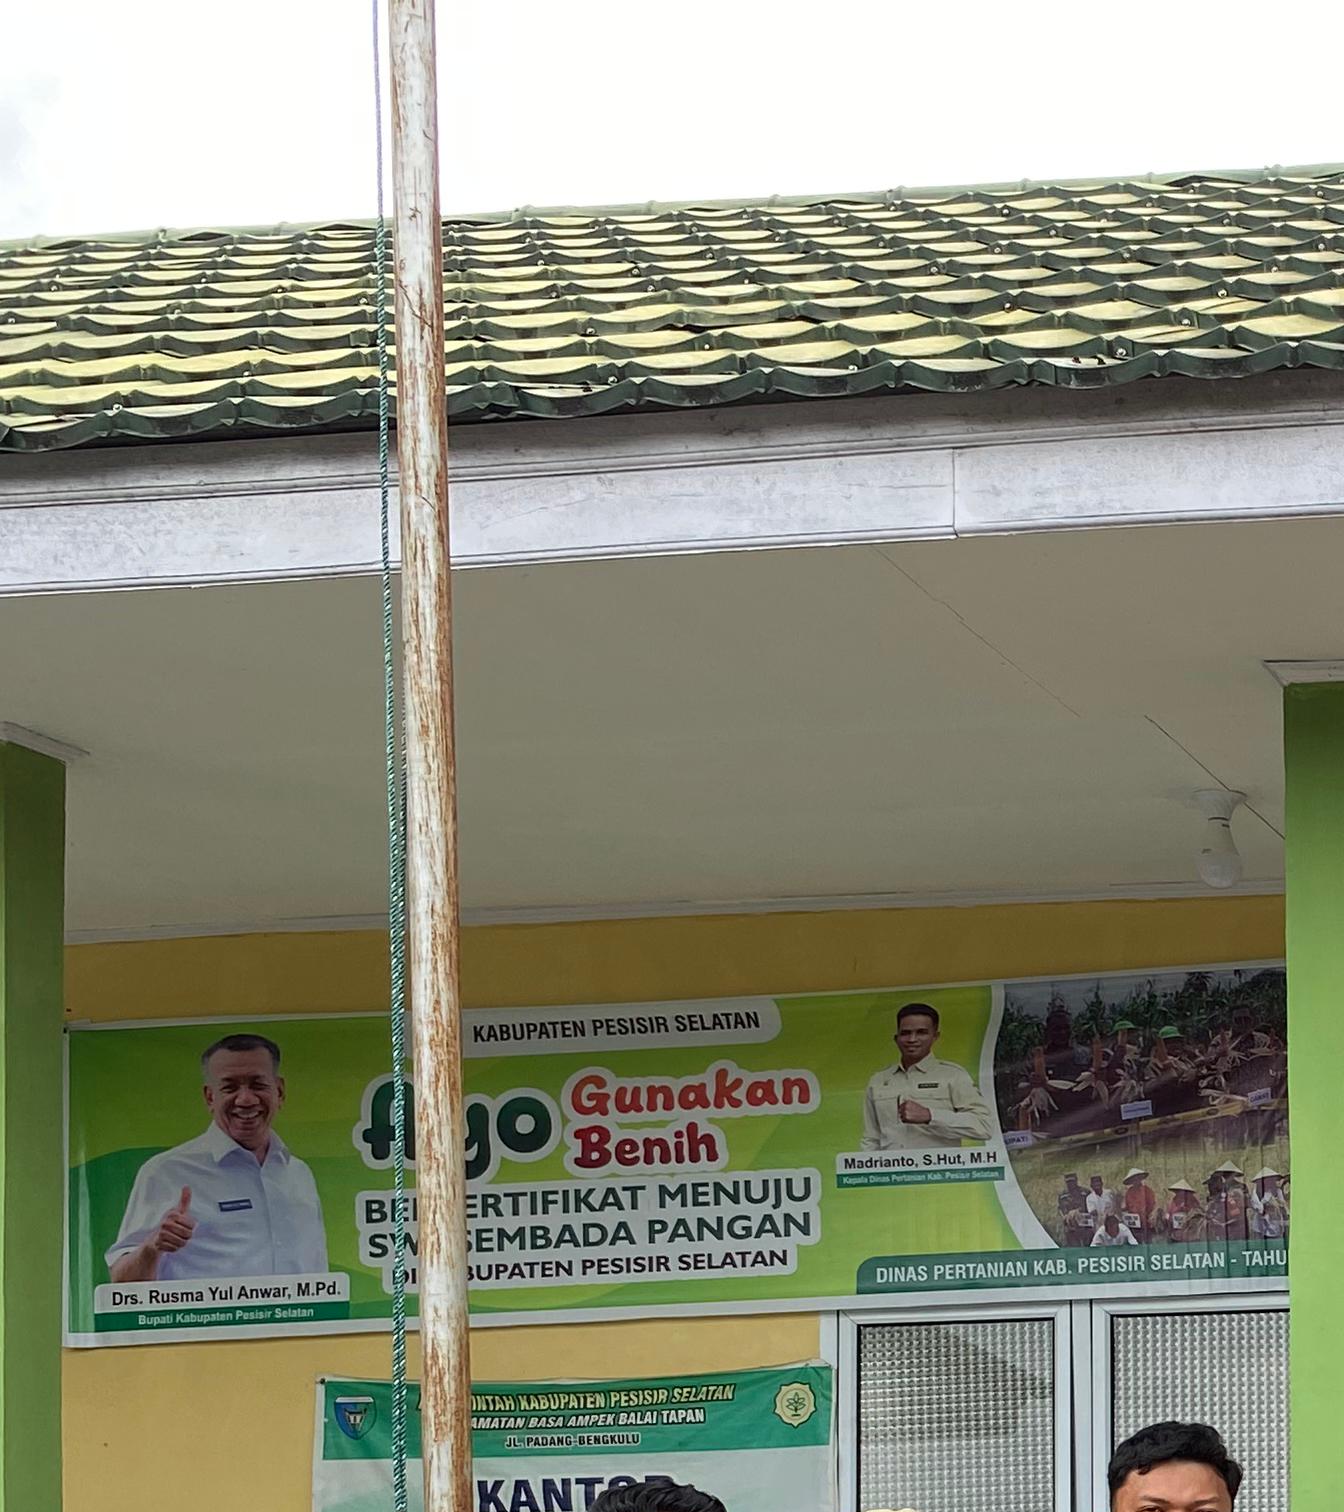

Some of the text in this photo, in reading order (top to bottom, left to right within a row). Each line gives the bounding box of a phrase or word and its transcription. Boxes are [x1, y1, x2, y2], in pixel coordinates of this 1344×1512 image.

[473, 1011, 760, 1043] KABUPATEN PESISIR SELATAN
[570, 1067, 811, 1117] Gunakan
[573, 1122, 719, 1168] Benih
[844, 1151, 997, 1169] Madrianto, S.Hut, M.H
[658, 1176, 811, 1210] MENUJU
[648, 1212, 811, 1245] PANGAN
[581, 1256, 670, 1276] PESISIR
[676, 1249, 788, 1271] SELATAN
[876, 1265, 928, 1284] DINAS
[933, 1261, 1028, 1282] PERTANIAN
[1033, 1258, 1071, 1277] KAB.
[1077, 1256, 1146, 1275] PESISIR
[1150, 1251, 1225, 1271] SELATAN
[1241, 1249, 1287, 1268] TAHU
[112, 1281, 341, 1306] Drs. Rusma Yul Anwar, M.Pd.
[138, 1306, 314, 1327] Bupati Kabupaten Pesisir Selatan
[520, 1392, 607, 1411] KABUPATEN
[610, 1389, 668, 1408] PESISIR
[671, 1384, 735, 1403] SELATAN
[471, 1408, 706, 1430] AMATAN BASA AMPEK BALAI TAPAN
